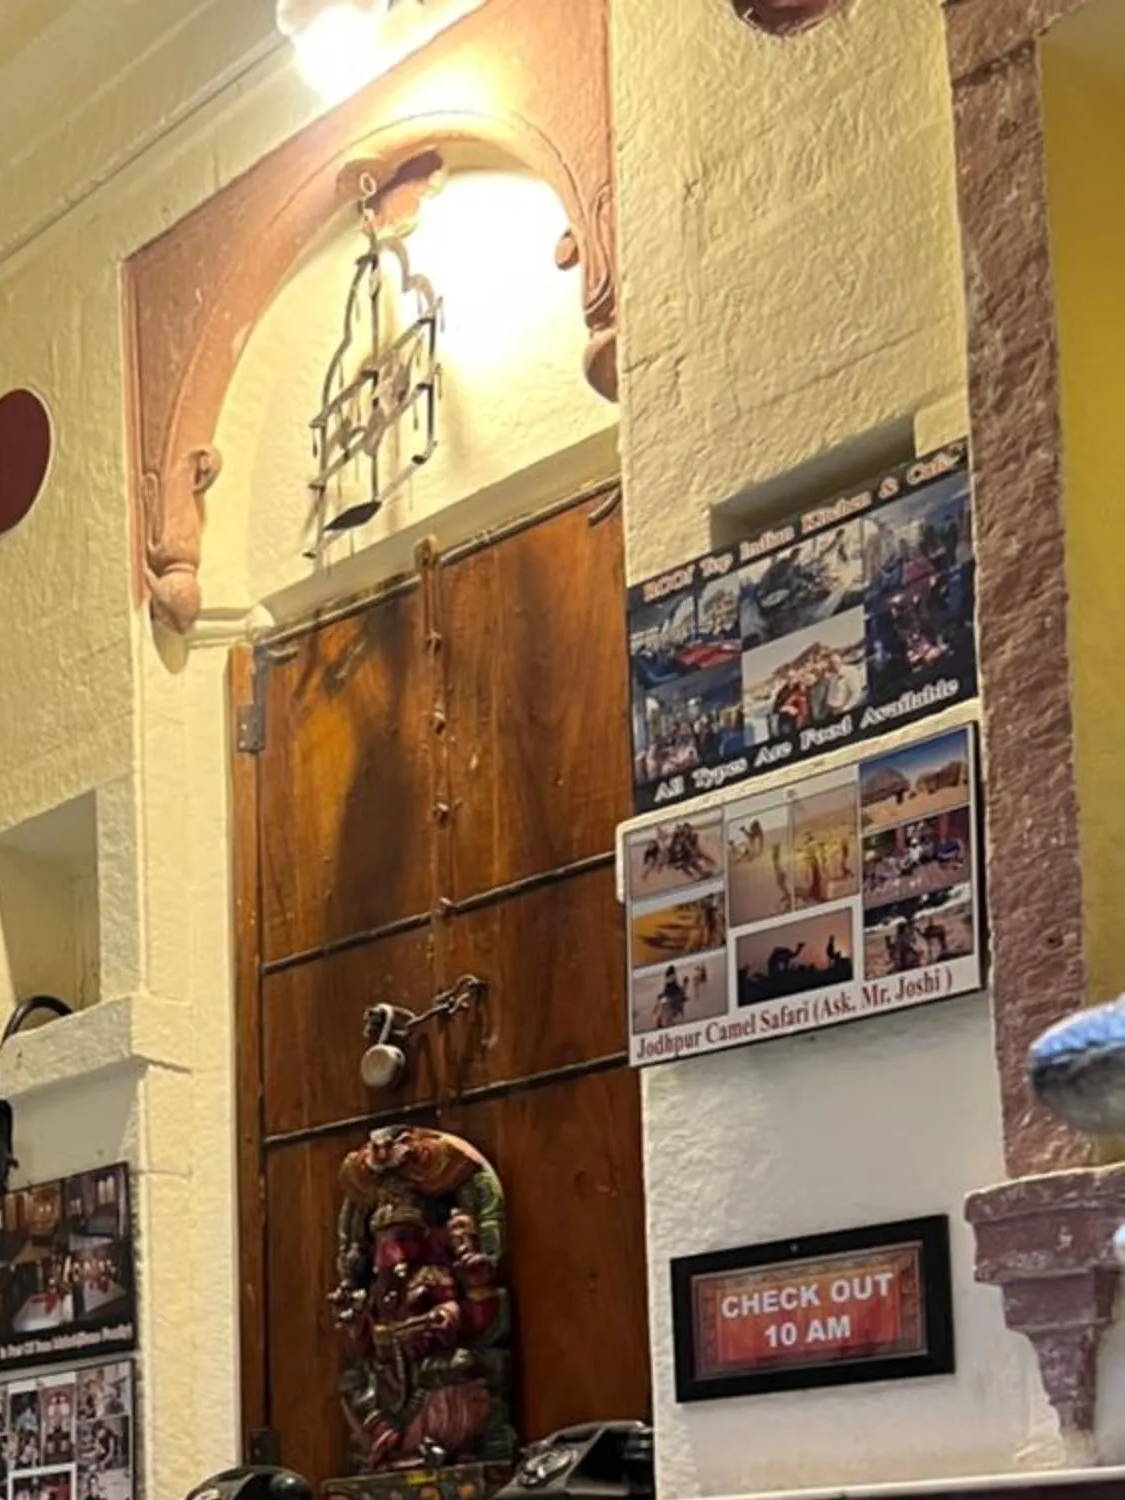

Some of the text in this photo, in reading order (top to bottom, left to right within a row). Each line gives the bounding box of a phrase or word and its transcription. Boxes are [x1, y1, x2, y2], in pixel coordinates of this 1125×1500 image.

[739, 524, 796, 563] Indian
[878, 475, 900, 500] &
[653, 775, 685, 803] All
[691, 757, 748, 790] Types
[859, 677, 960, 730] Available
[637, 1030, 703, 1060] Jodhpur
[705, 1013, 757, 1044] Camel
[760, 1001, 810, 1033] Safari
[862, 983, 892, 1009] Mr.
[894, 967, 941, 1001] Joshi
[721, 1272, 894, 1319] CHECK OUT
[765, 1315, 851, 1348] 10 AM
